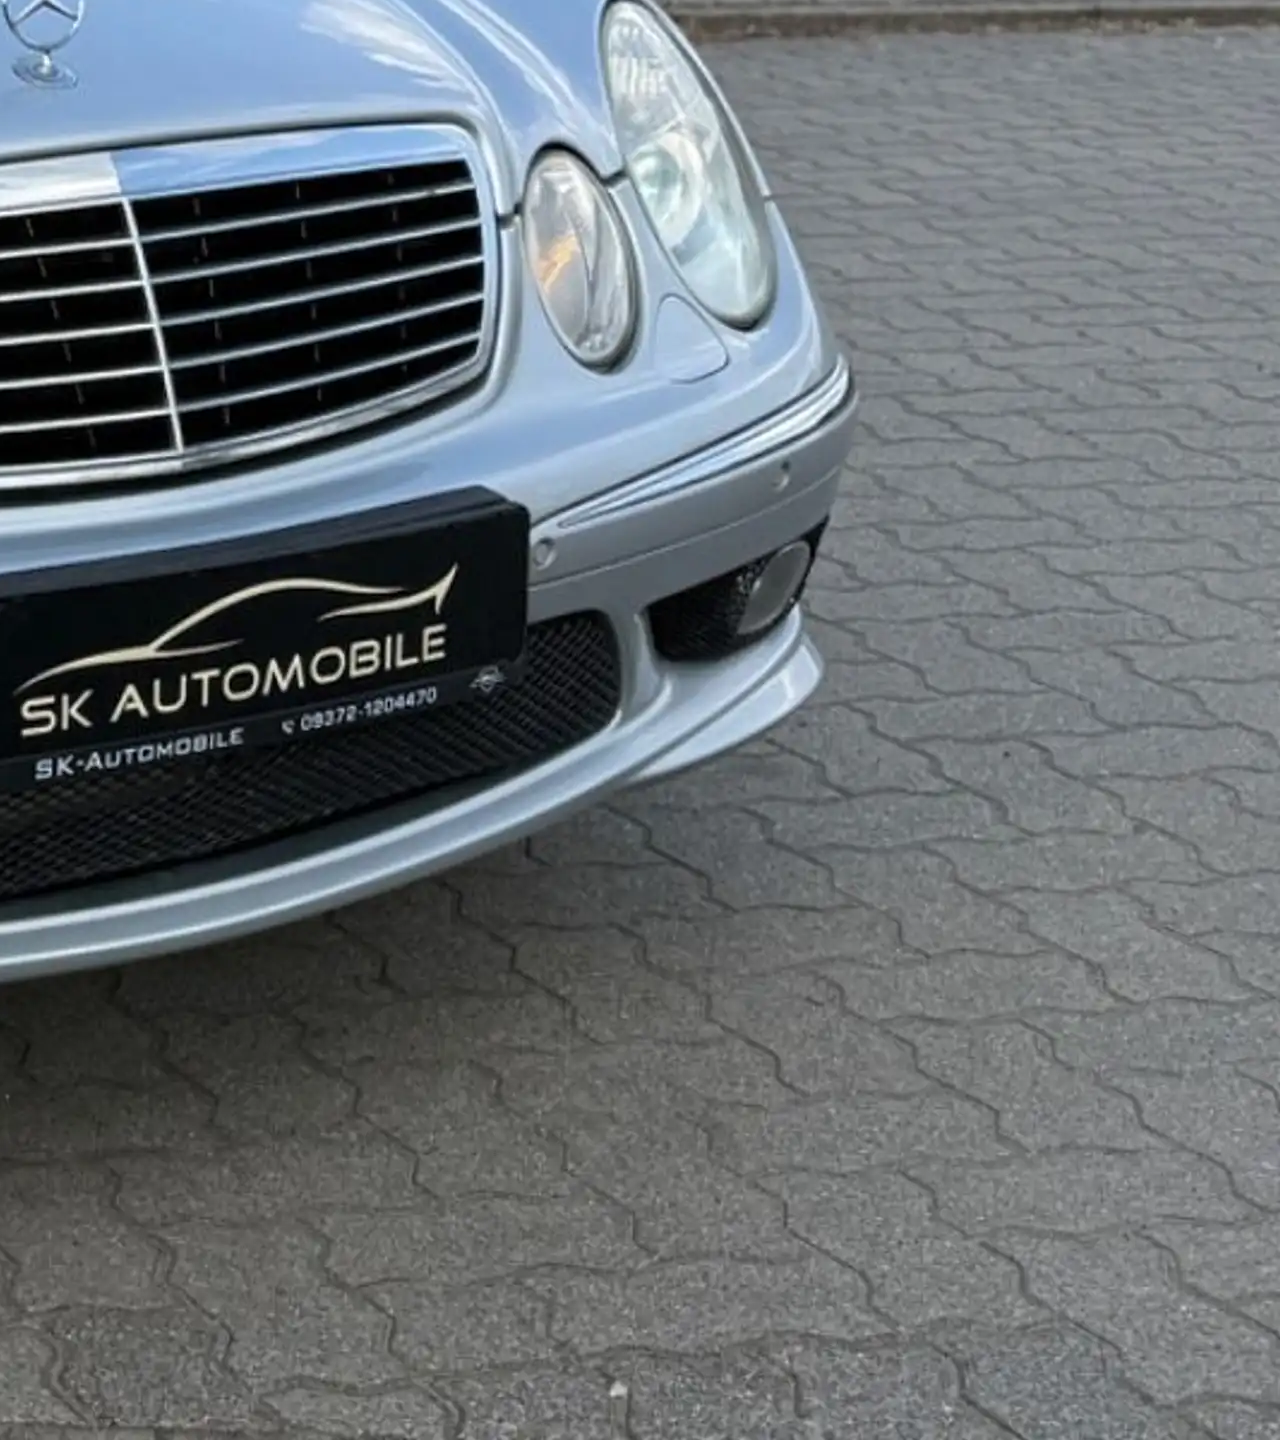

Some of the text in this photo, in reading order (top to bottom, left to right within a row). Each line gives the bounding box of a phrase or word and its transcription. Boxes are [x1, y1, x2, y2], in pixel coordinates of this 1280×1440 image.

[20, 623, 447, 737] SK AUTOMOBILE
[34, 727, 244, 780] SK-AUTOMOBILE
